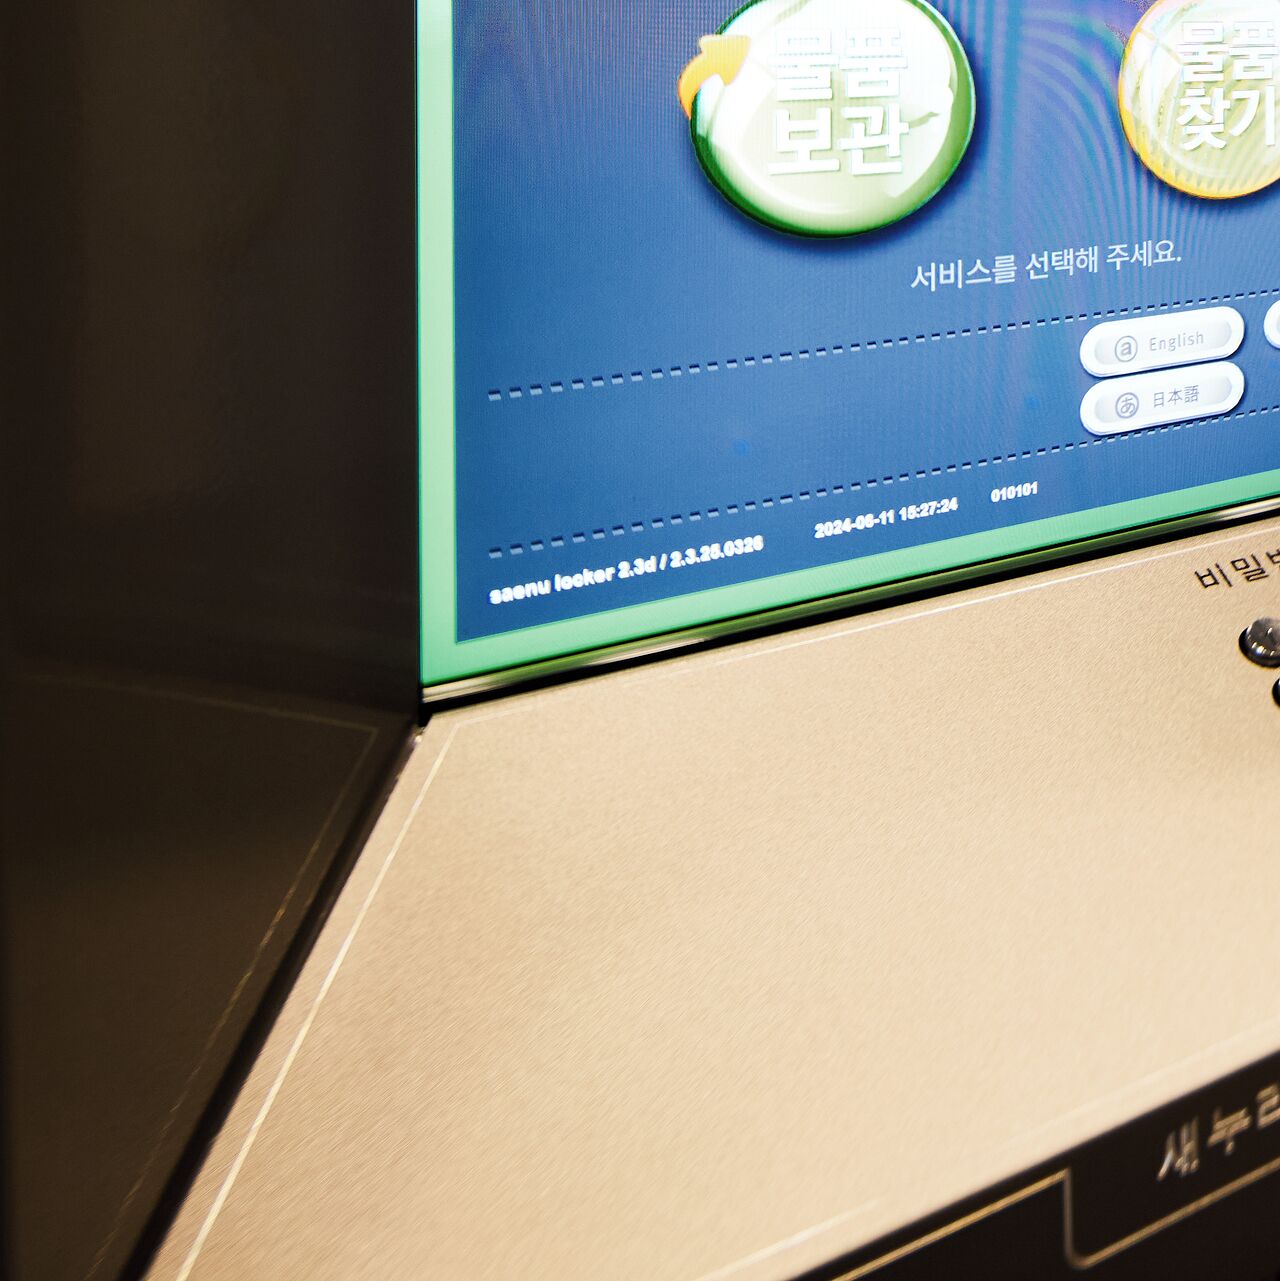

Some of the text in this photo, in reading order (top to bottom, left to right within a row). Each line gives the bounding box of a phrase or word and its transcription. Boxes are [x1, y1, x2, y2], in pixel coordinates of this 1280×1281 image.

[767, 28, 908, 102] 물품
[1177, 20, 1279, 83] 물품
[767, 103, 910, 176] 보관
[1176, 85, 1276, 151] 찾기
[911, 239, 1182, 292] 서비스를 선택해 주세요.
[1149, 331, 1205, 352] English
[1153, 384, 1199, 409] 日本語
[990, 481, 1038, 503] 010101
[814, 509, 895, 539] 2024-06-11
[489, 579, 551, 605] saenu
[553, 567, 616, 592] locker
